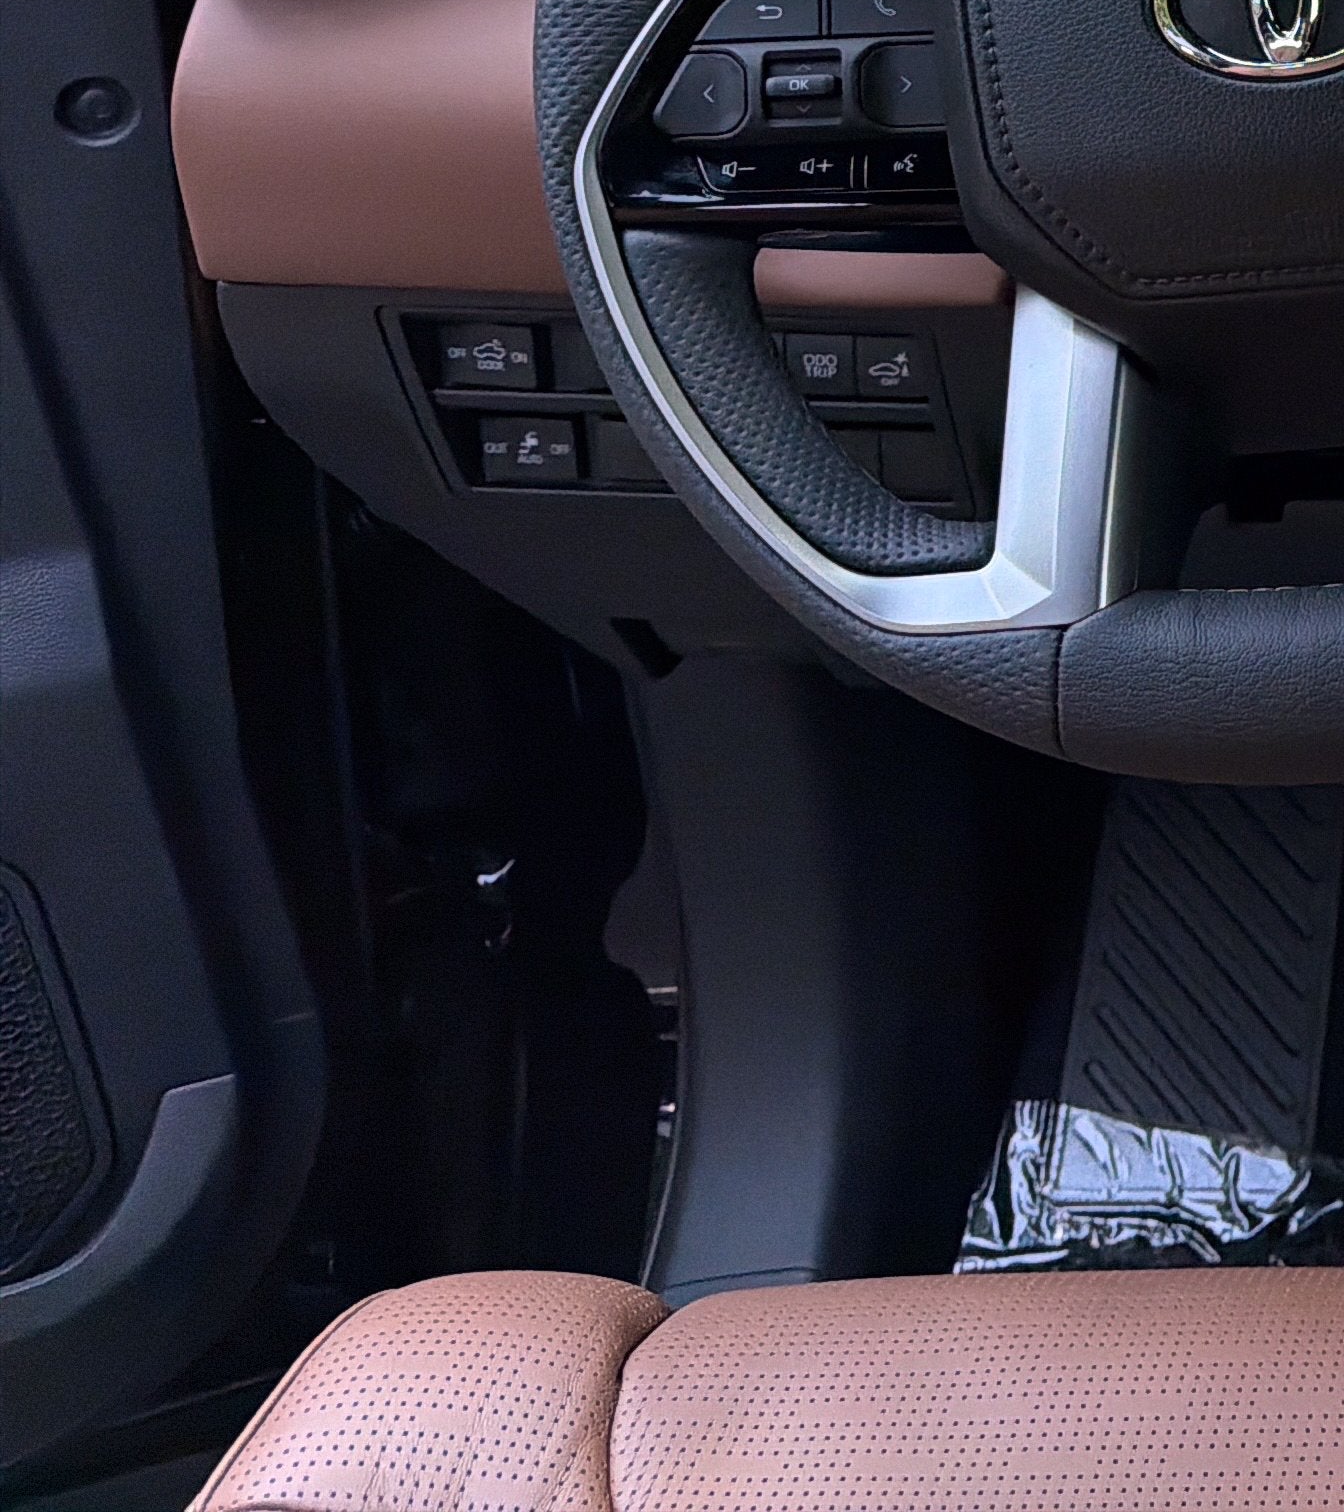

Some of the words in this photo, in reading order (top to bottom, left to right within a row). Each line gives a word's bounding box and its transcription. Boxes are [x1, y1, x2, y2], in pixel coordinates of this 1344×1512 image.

[788, 76, 810, 92] OK
[447, 346, 467, 359] OFF
[510, 351, 528, 364] ON
[803, 353, 838, 367] ODO
[804, 365, 838, 378] TRIP
